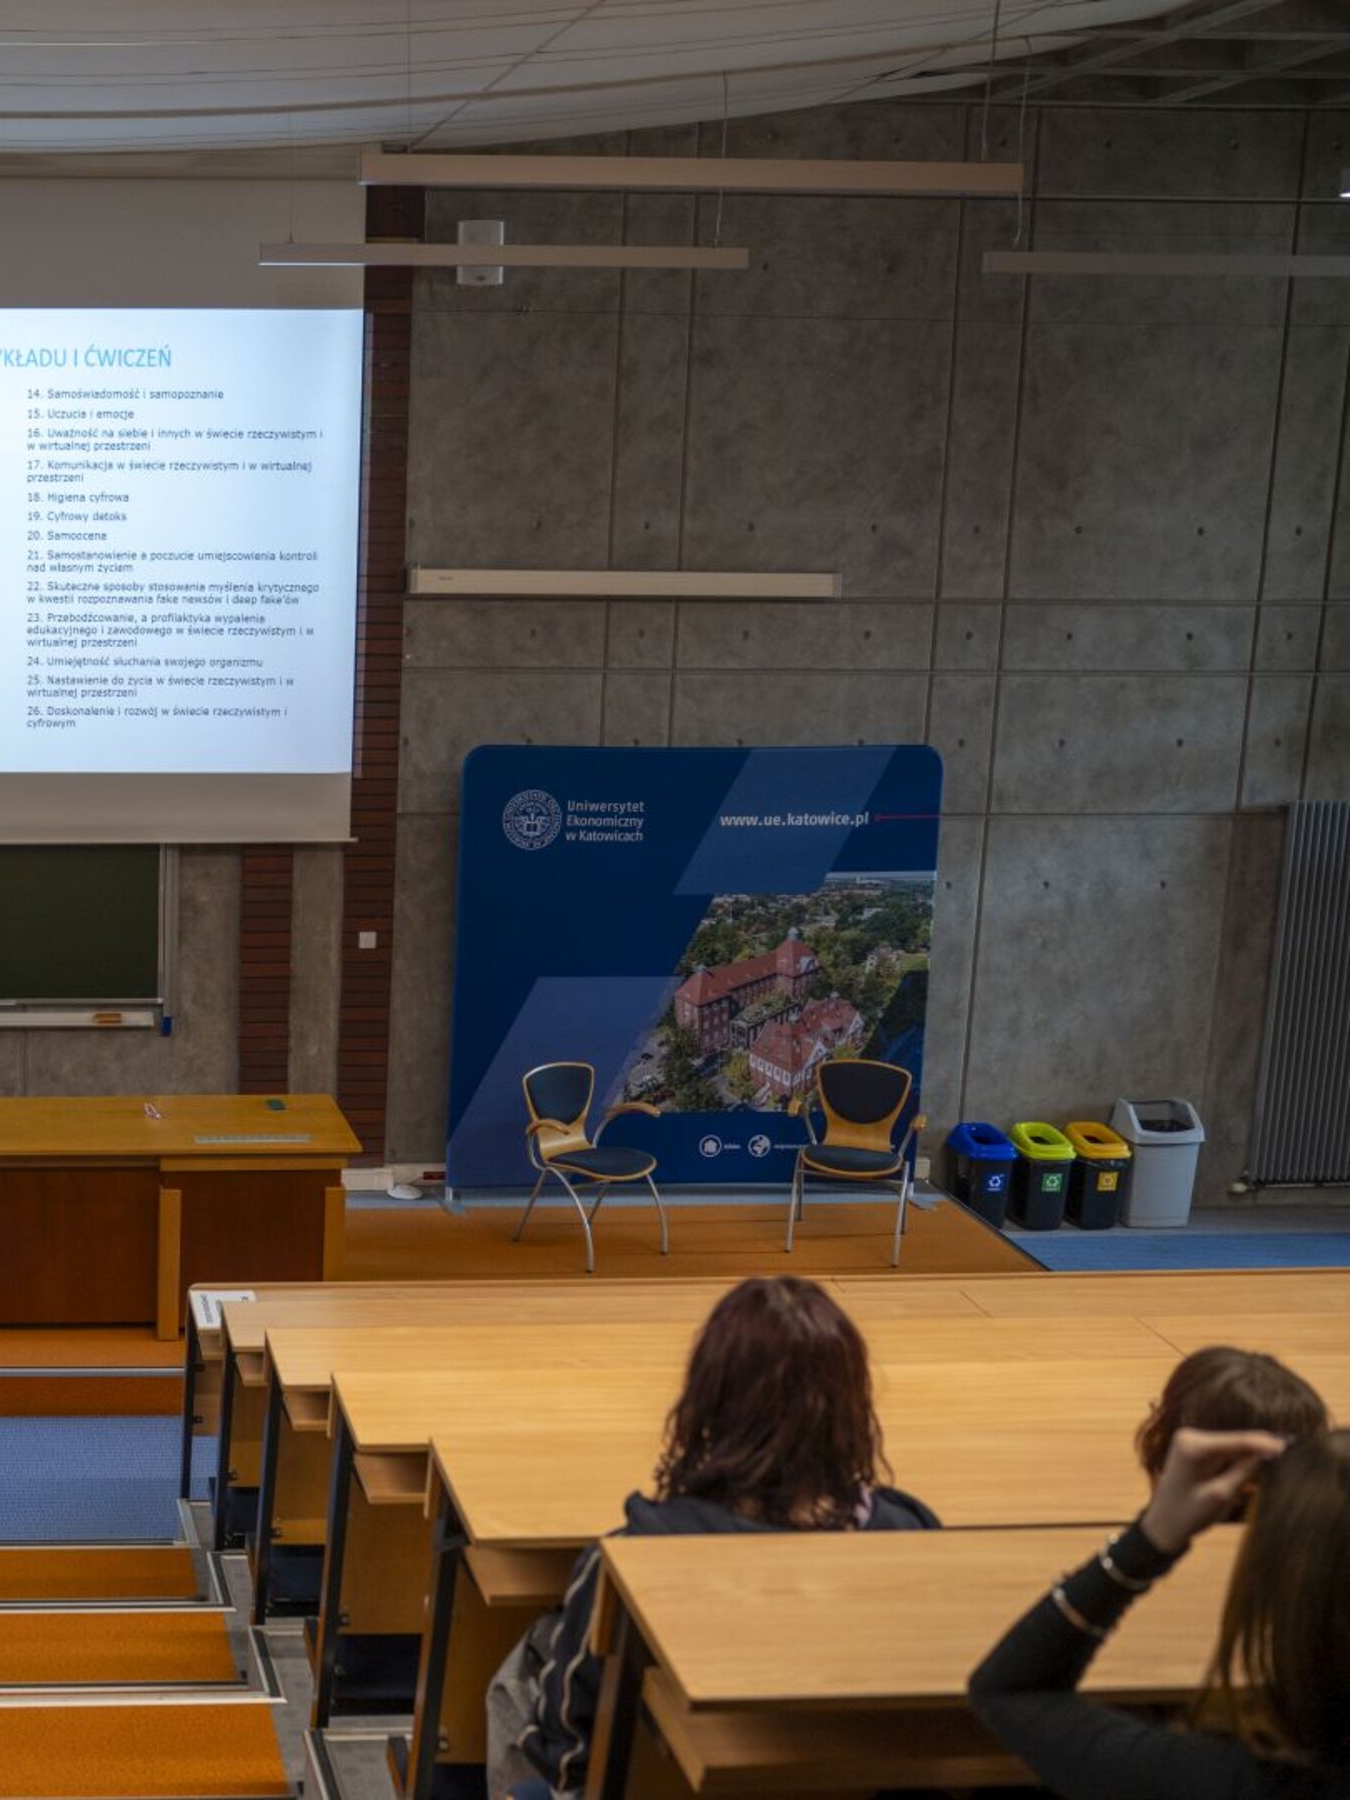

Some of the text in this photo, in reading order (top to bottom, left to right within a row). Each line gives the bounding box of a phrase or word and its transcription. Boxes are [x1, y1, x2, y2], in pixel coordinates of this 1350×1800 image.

[73, 350, 78, 367] I
[85, 344, 172, 368] ĆWICZEŃ
[48, 409, 87, 419] Uczucia
[96, 409, 134, 421] emocje
[118, 429, 148, 438] siebie
[158, 429, 191, 440] innych
[206, 428, 244, 438] świecie
[129, 460, 166, 470] świecie
[48, 493, 86, 504] Higiena
[89, 493, 129, 504] cyfrowa
[47, 511, 89, 523] Cyfrowy
[93, 511, 127, 521] detoks
[150, 551, 194, 562] poczucie
[26, 562, 46, 572] nad
[102, 582, 145, 593] sposoby
[208, 581, 254, 593] myślenia
[39, 594, 74, 603] kwestii
[156, 594, 179, 604] fake
[232, 594, 257, 606] deep
[188, 625, 224, 635] świecie
[164, 657, 206, 669] swojego
[168, 675, 204, 686] świecie
[124, 706, 157, 718] rozwój
[172, 706, 209, 716] świecie
[26, 718, 76, 730] cyfrowym
[567, 800, 645, 814] Uniwersytet
[566, 815, 644, 829] Ekonomiczny
[720, 811, 869, 827] www.ue.katowice.pl
[566, 830, 643, 842] w Katowicach
